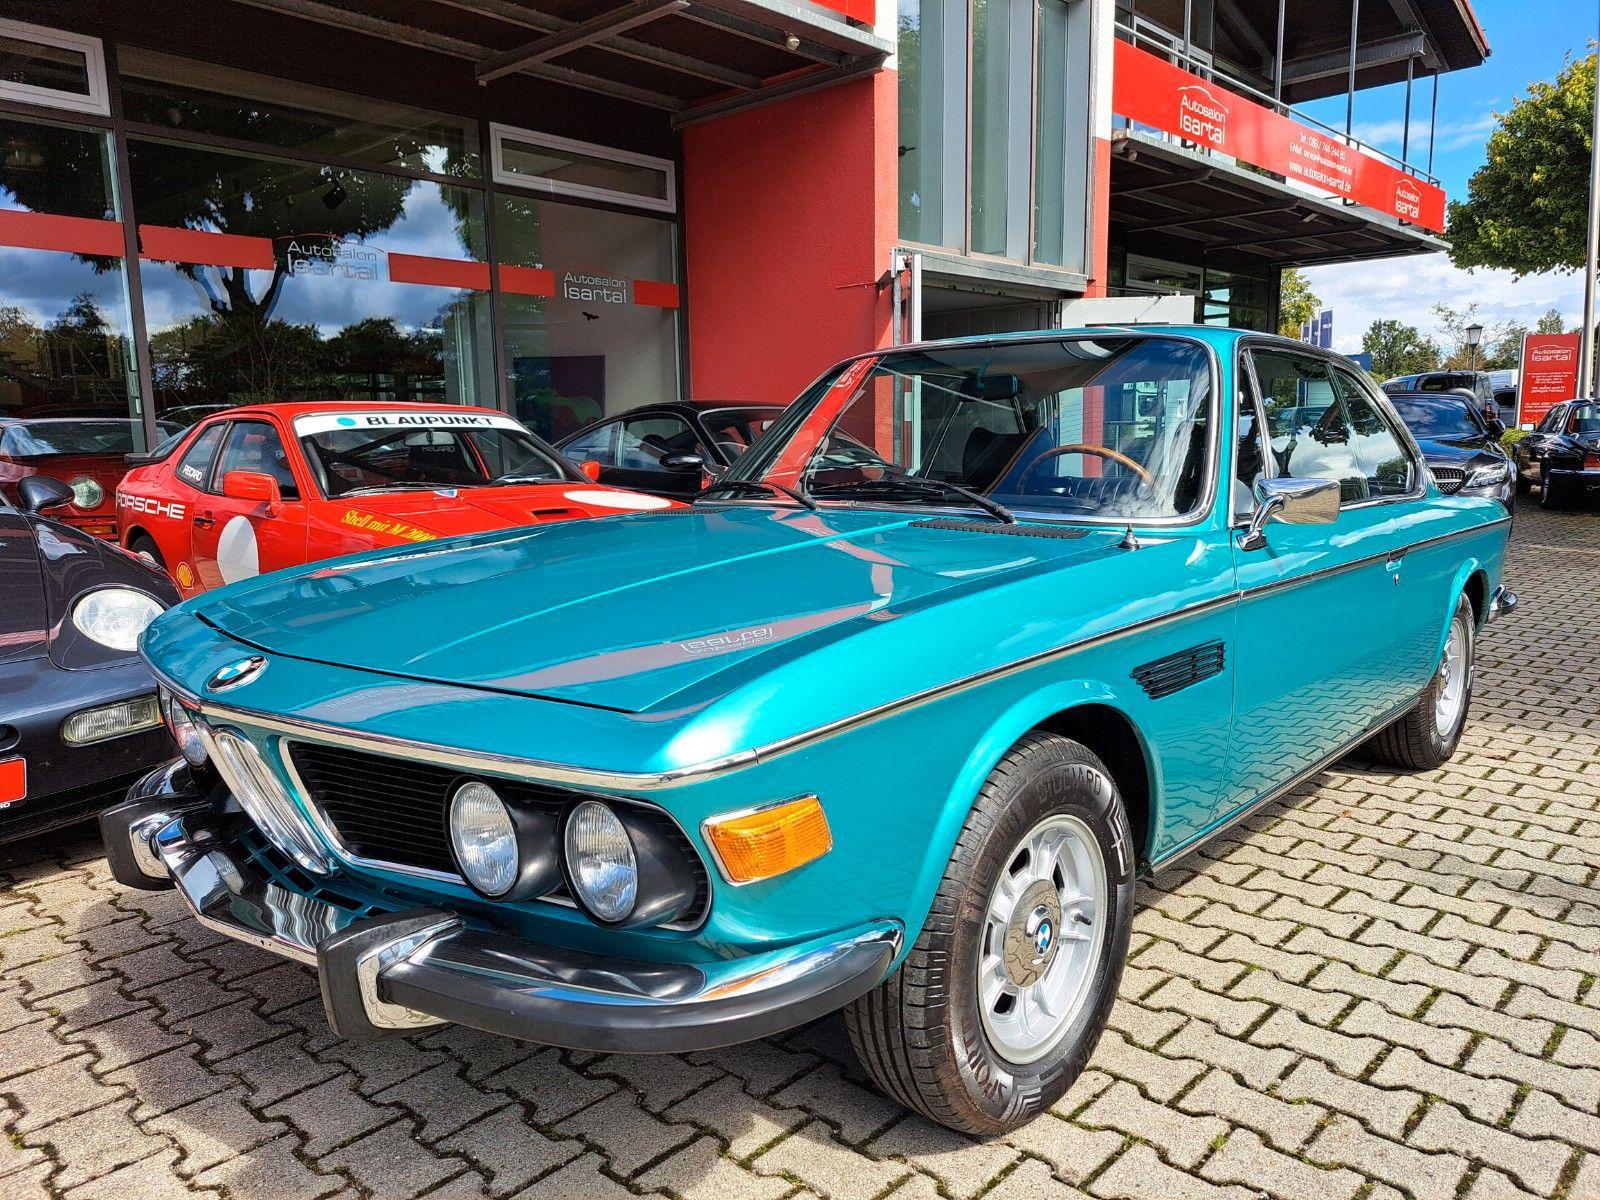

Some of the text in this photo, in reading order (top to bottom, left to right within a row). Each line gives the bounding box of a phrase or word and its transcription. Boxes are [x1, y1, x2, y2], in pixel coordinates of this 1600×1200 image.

[1181, 94, 1226, 124] Autosalon
[1180, 107, 1225, 145] Isartal
[1396, 186, 1420, 204] Autosalon
[1395, 195, 1420, 219] Isartal
[287, 240, 377, 261] Autosalon
[287, 253, 379, 280] Isartal
[564, 271, 626, 288] Autosalon
[563, 282, 627, 304] Isartal
[366, 416, 494, 425] BLAUPUNKT
[183, 464, 203, 482] RECARO
[117, 492, 186, 520] PORSCHE
[341, 509, 374, 528] Shell
